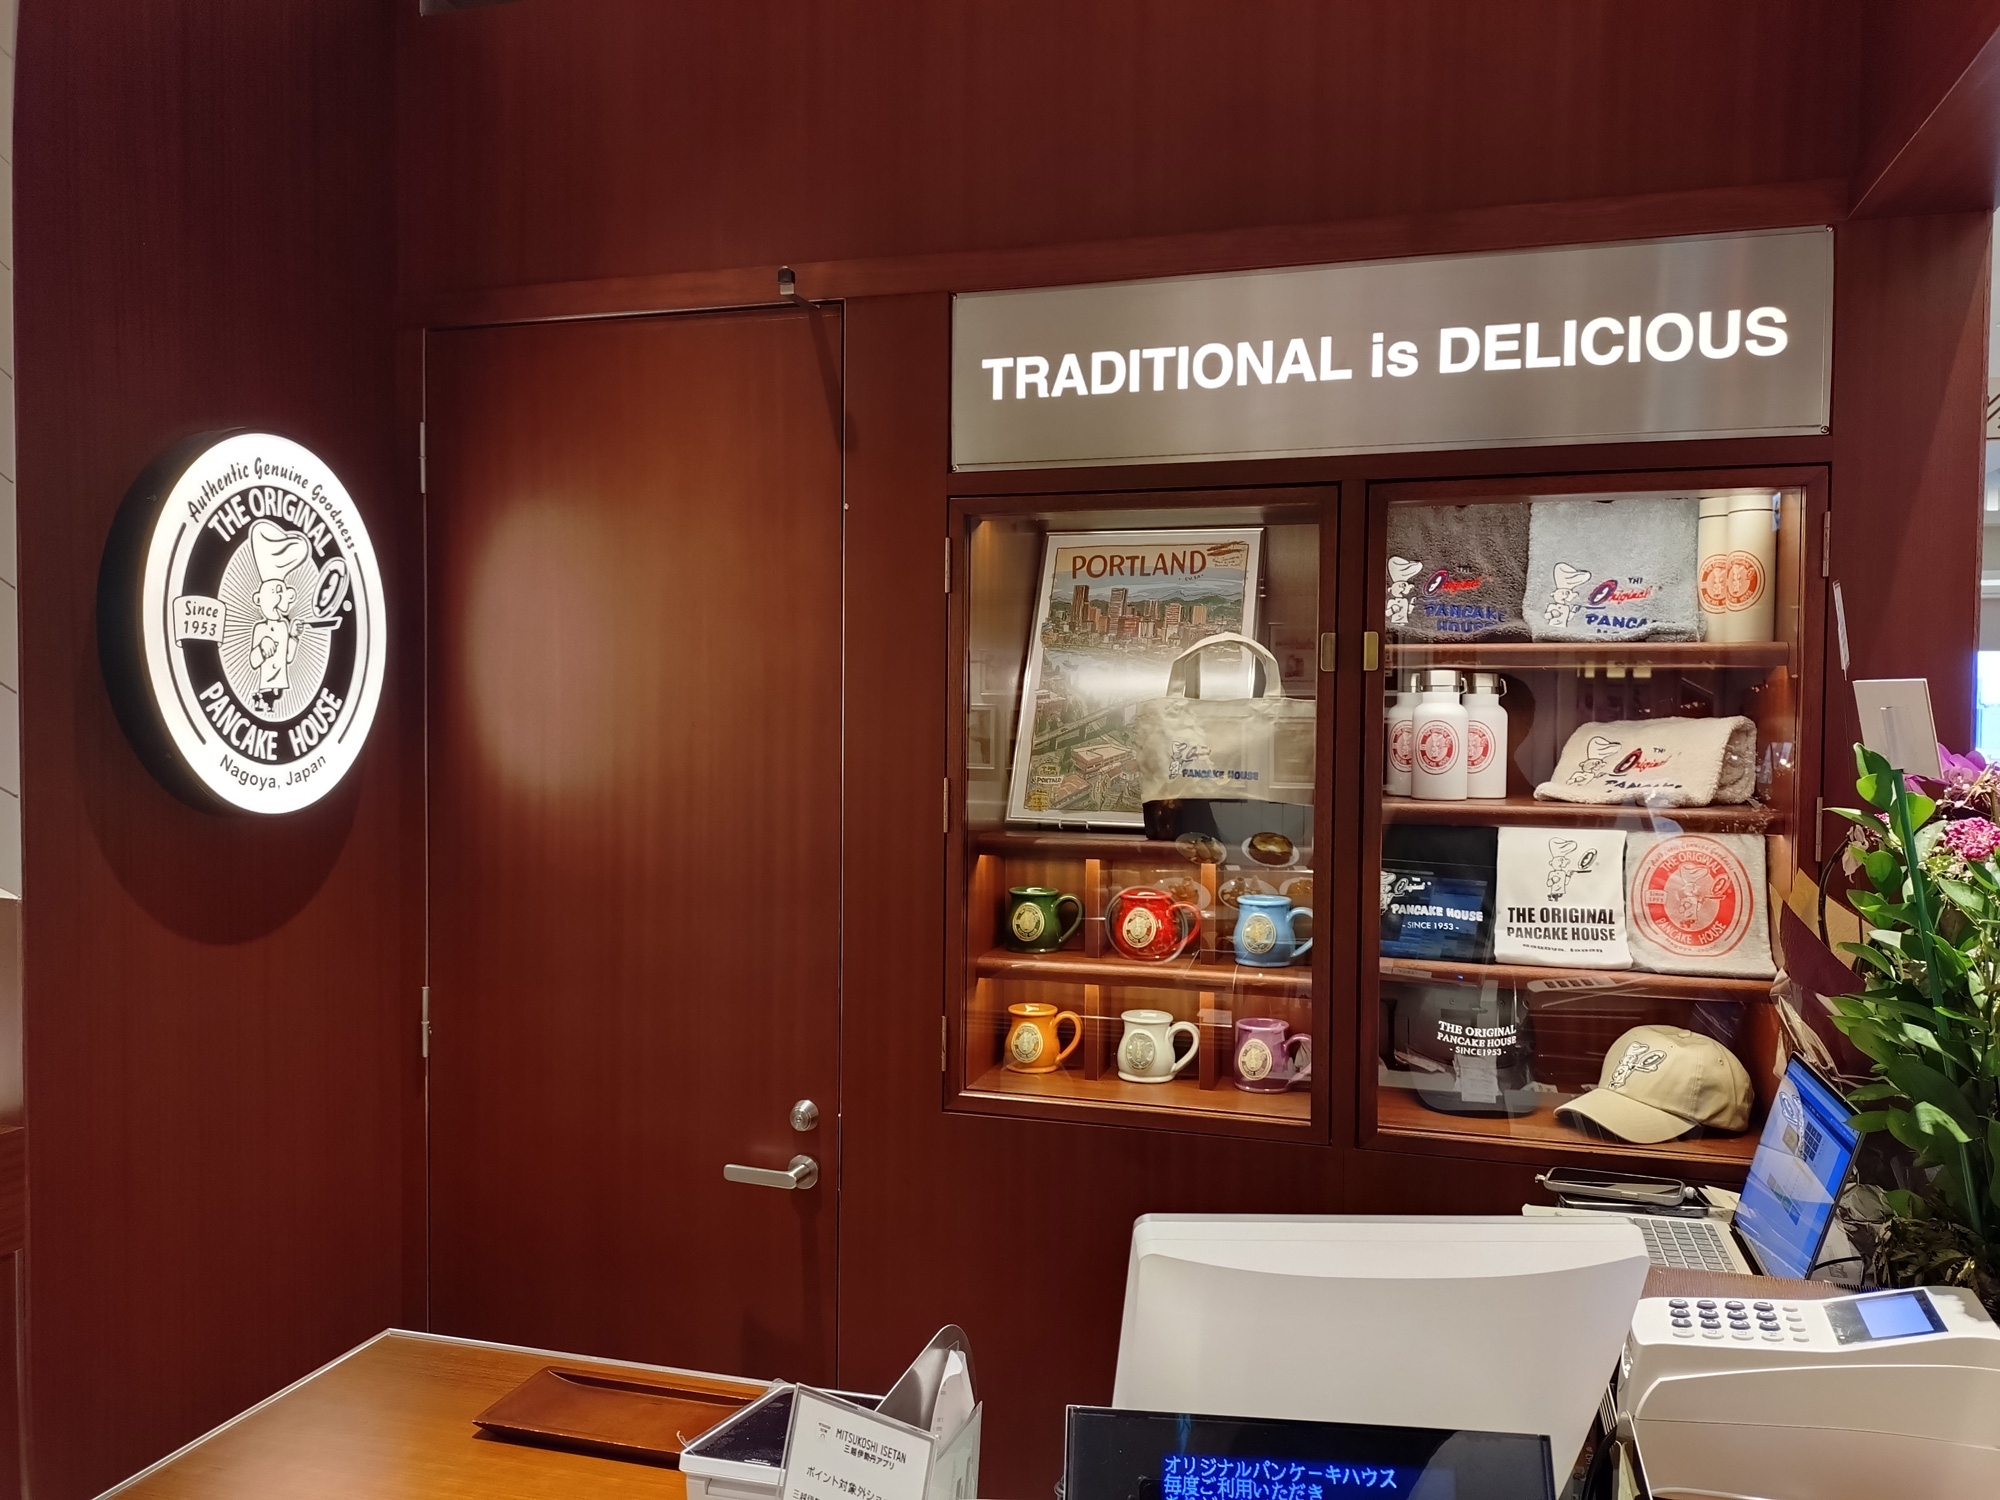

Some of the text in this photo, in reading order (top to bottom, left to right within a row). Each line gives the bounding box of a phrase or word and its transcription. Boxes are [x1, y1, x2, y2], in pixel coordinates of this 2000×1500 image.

[982, 306, 1790, 400] TRADITIONAL is DELICIOUS
[187, 456, 355, 550] Authentic Genuine Goodness
[207, 487, 333, 558] THE ORIGINAL
[1072, 550, 1207, 580] PORTLAND
[185, 600, 219, 618] Since
[1425, 603, 1507, 623] PANCAKE
[184, 620, 217, 637] 1953
[200, 681, 343, 761] PANCAKE HOUSE
[219, 754, 327, 791] Nagoya, Japan
[1228, 769, 1259, 781] HOUSE
[1660, 851, 1721, 874] THE ORIGINAL
[1391, 903, 1484, 922] PANCAKE HOUSE
[1507, 907, 1616, 925] THE ORIGINAL
[1407, 921, 1454, 930] SINCE 1953
[1507, 926, 1616, 941] PANCAKE HOUSE
[1655, 917, 1727, 945] PANCAKE HOUSE
[1437, 1031, 1517, 1048] PANCAKE HOUSE
[1438, 1020, 1517, 1038] THE ORIGINAL
[835, 1428, 907, 1465] MITSUKOSHI ISETAN
[1165, 1456, 1398, 1490] オリジナルパンケーキハウス
[1164, 1473, 1324, 1500] 毎度ご利用いただき
